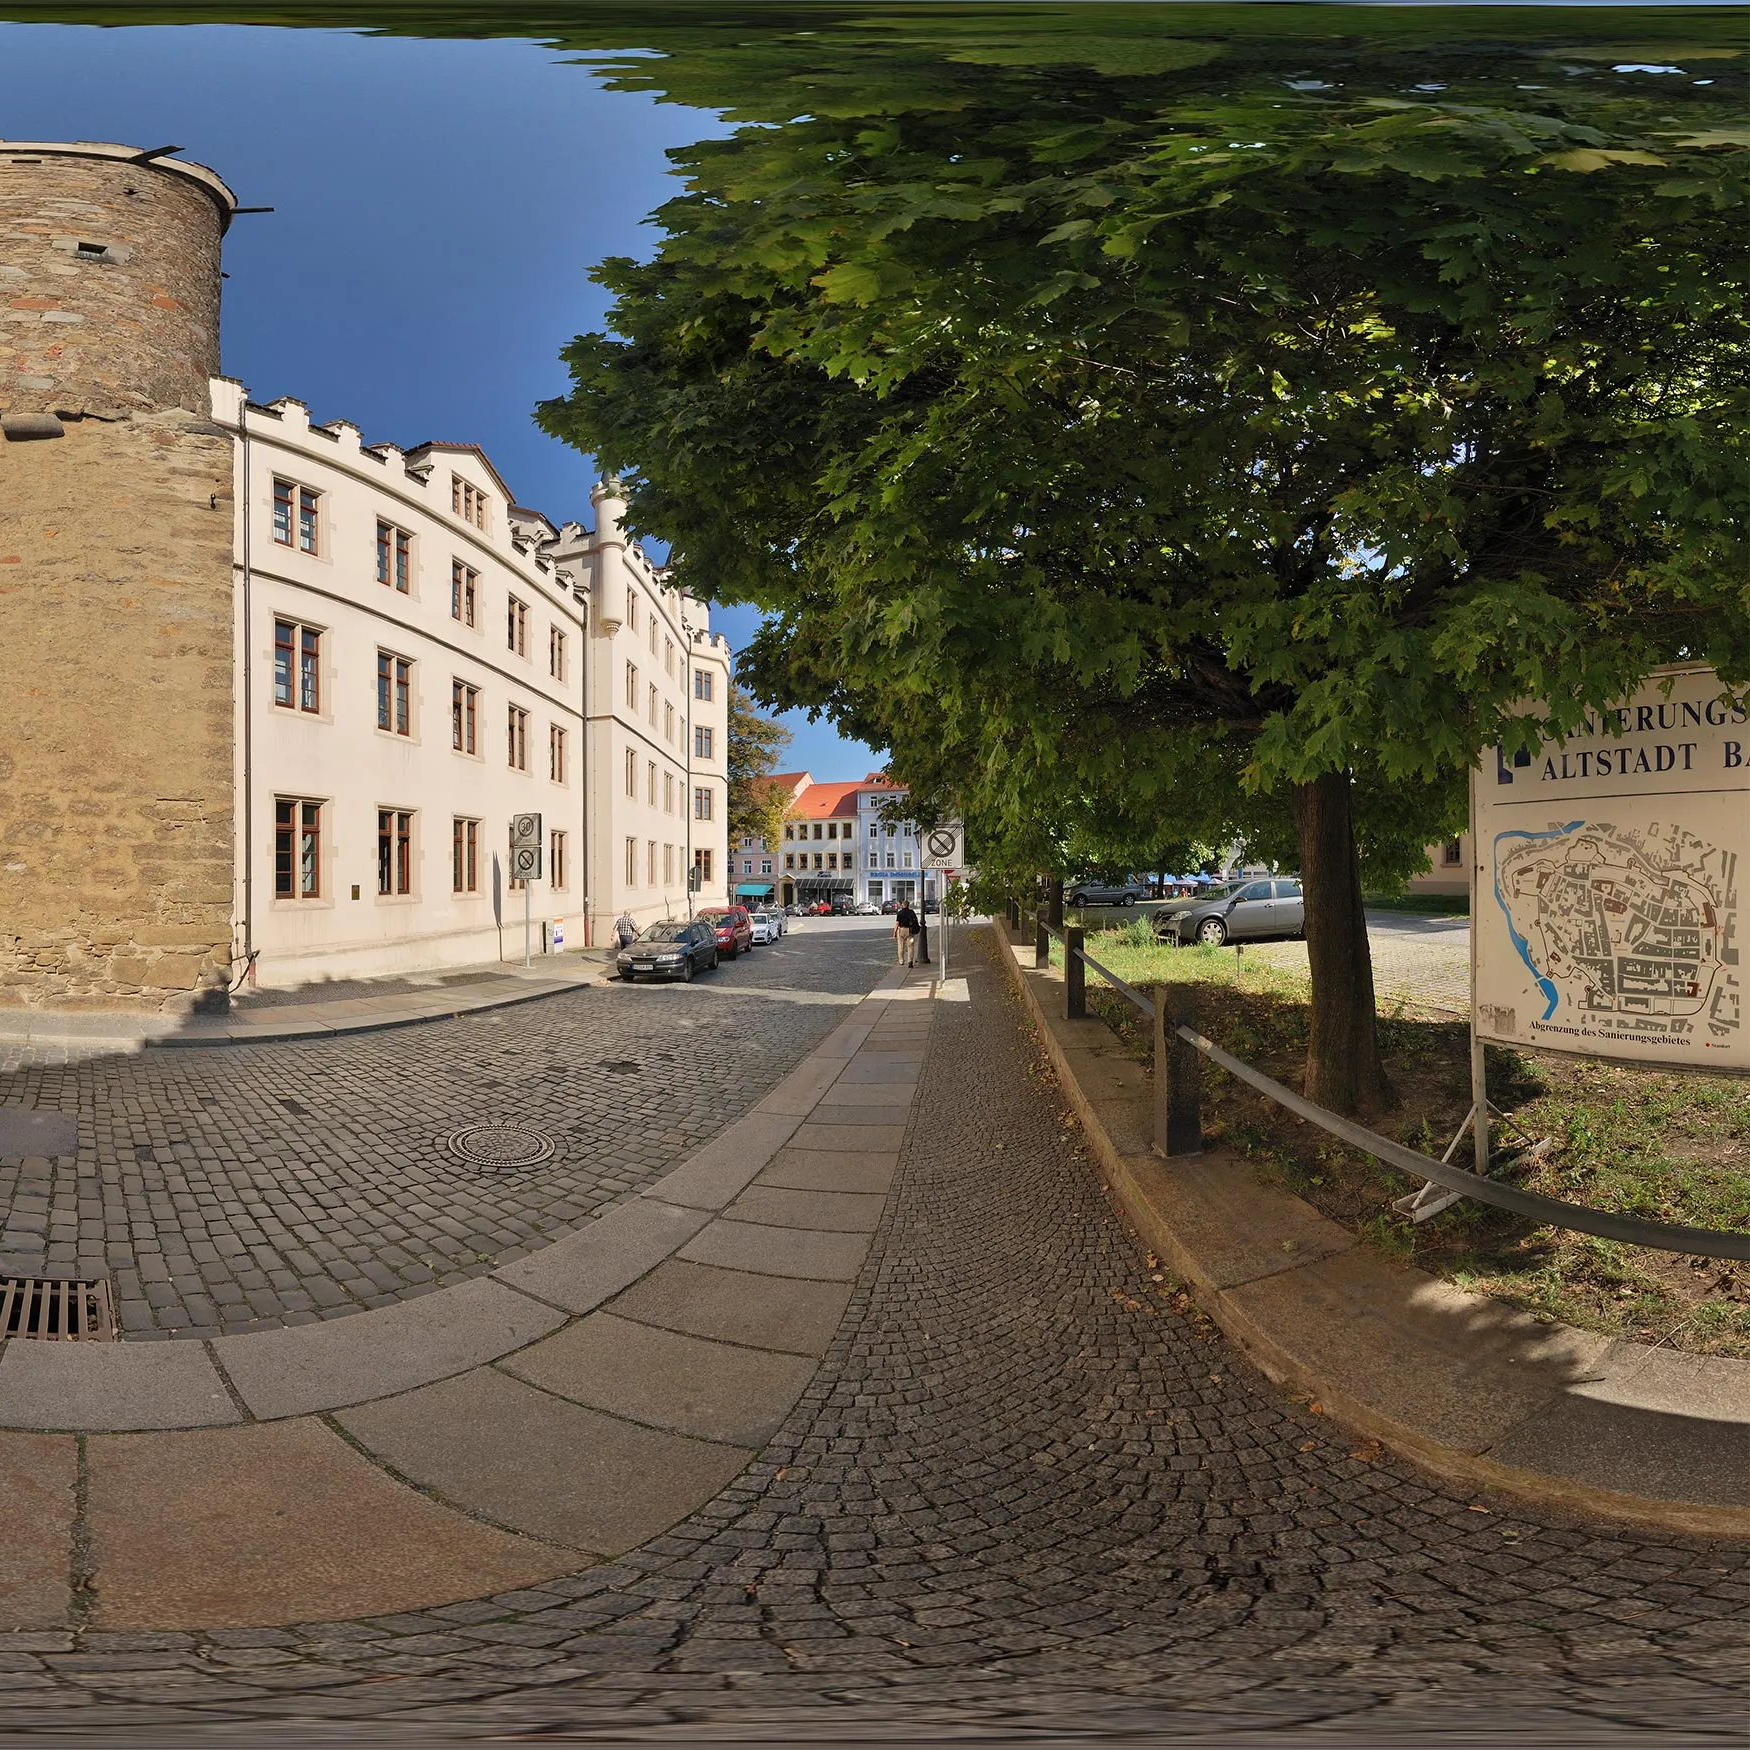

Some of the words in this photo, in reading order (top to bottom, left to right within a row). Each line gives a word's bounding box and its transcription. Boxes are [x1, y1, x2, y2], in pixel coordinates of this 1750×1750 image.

[1541, 743, 1697, 780] ALTSTADT
[1722, 741, 1750, 768] B
[521, 822, 531, 832] 30
[1529, 1021, 1580, 1037] Abgrenzung
[1581, 1027, 1597, 1037] des
[1598, 1029, 1691, 1046] Sanierungsgebietes
